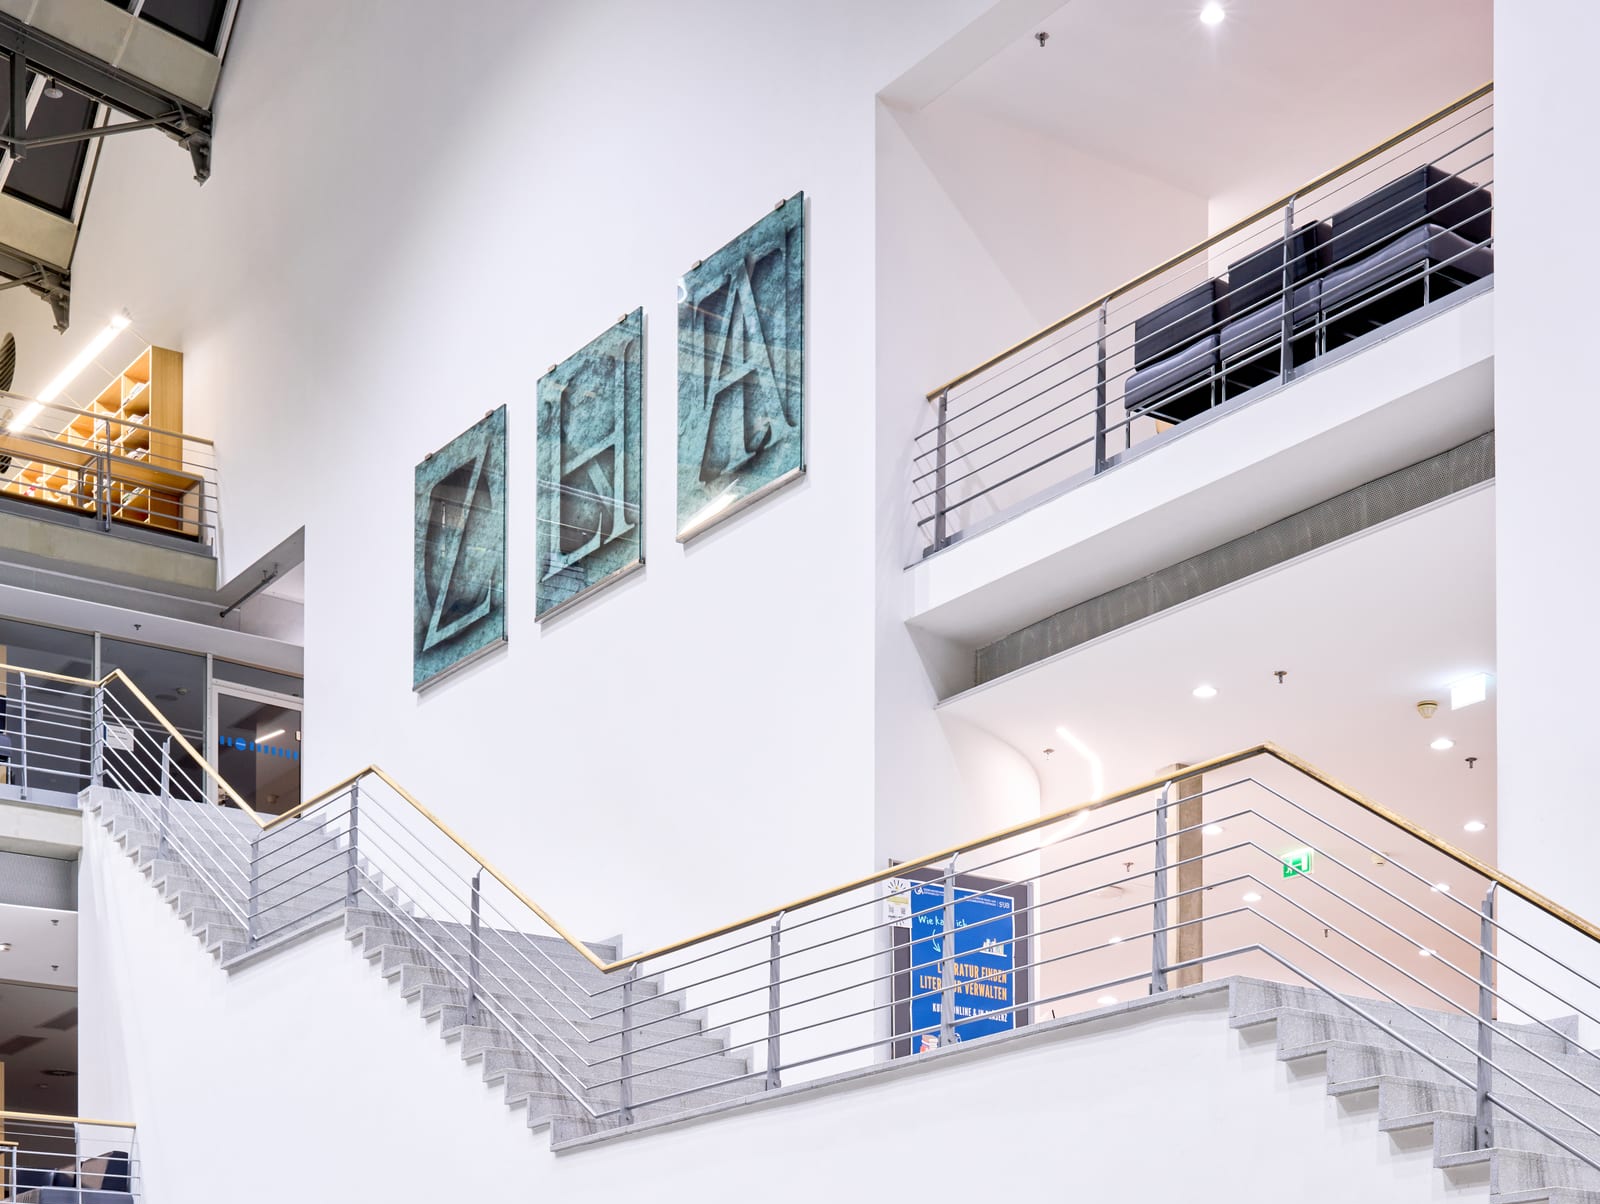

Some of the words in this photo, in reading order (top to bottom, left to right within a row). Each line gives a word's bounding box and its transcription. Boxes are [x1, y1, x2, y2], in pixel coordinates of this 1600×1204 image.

[918, 915, 934, 924] Wie
[937, 962, 979, 979] LRATUR
[981, 966, 1007, 984] FINDEN
[919, 975, 962, 994] LITERUR
[964, 983, 1007, 1001] VERWALTEN
